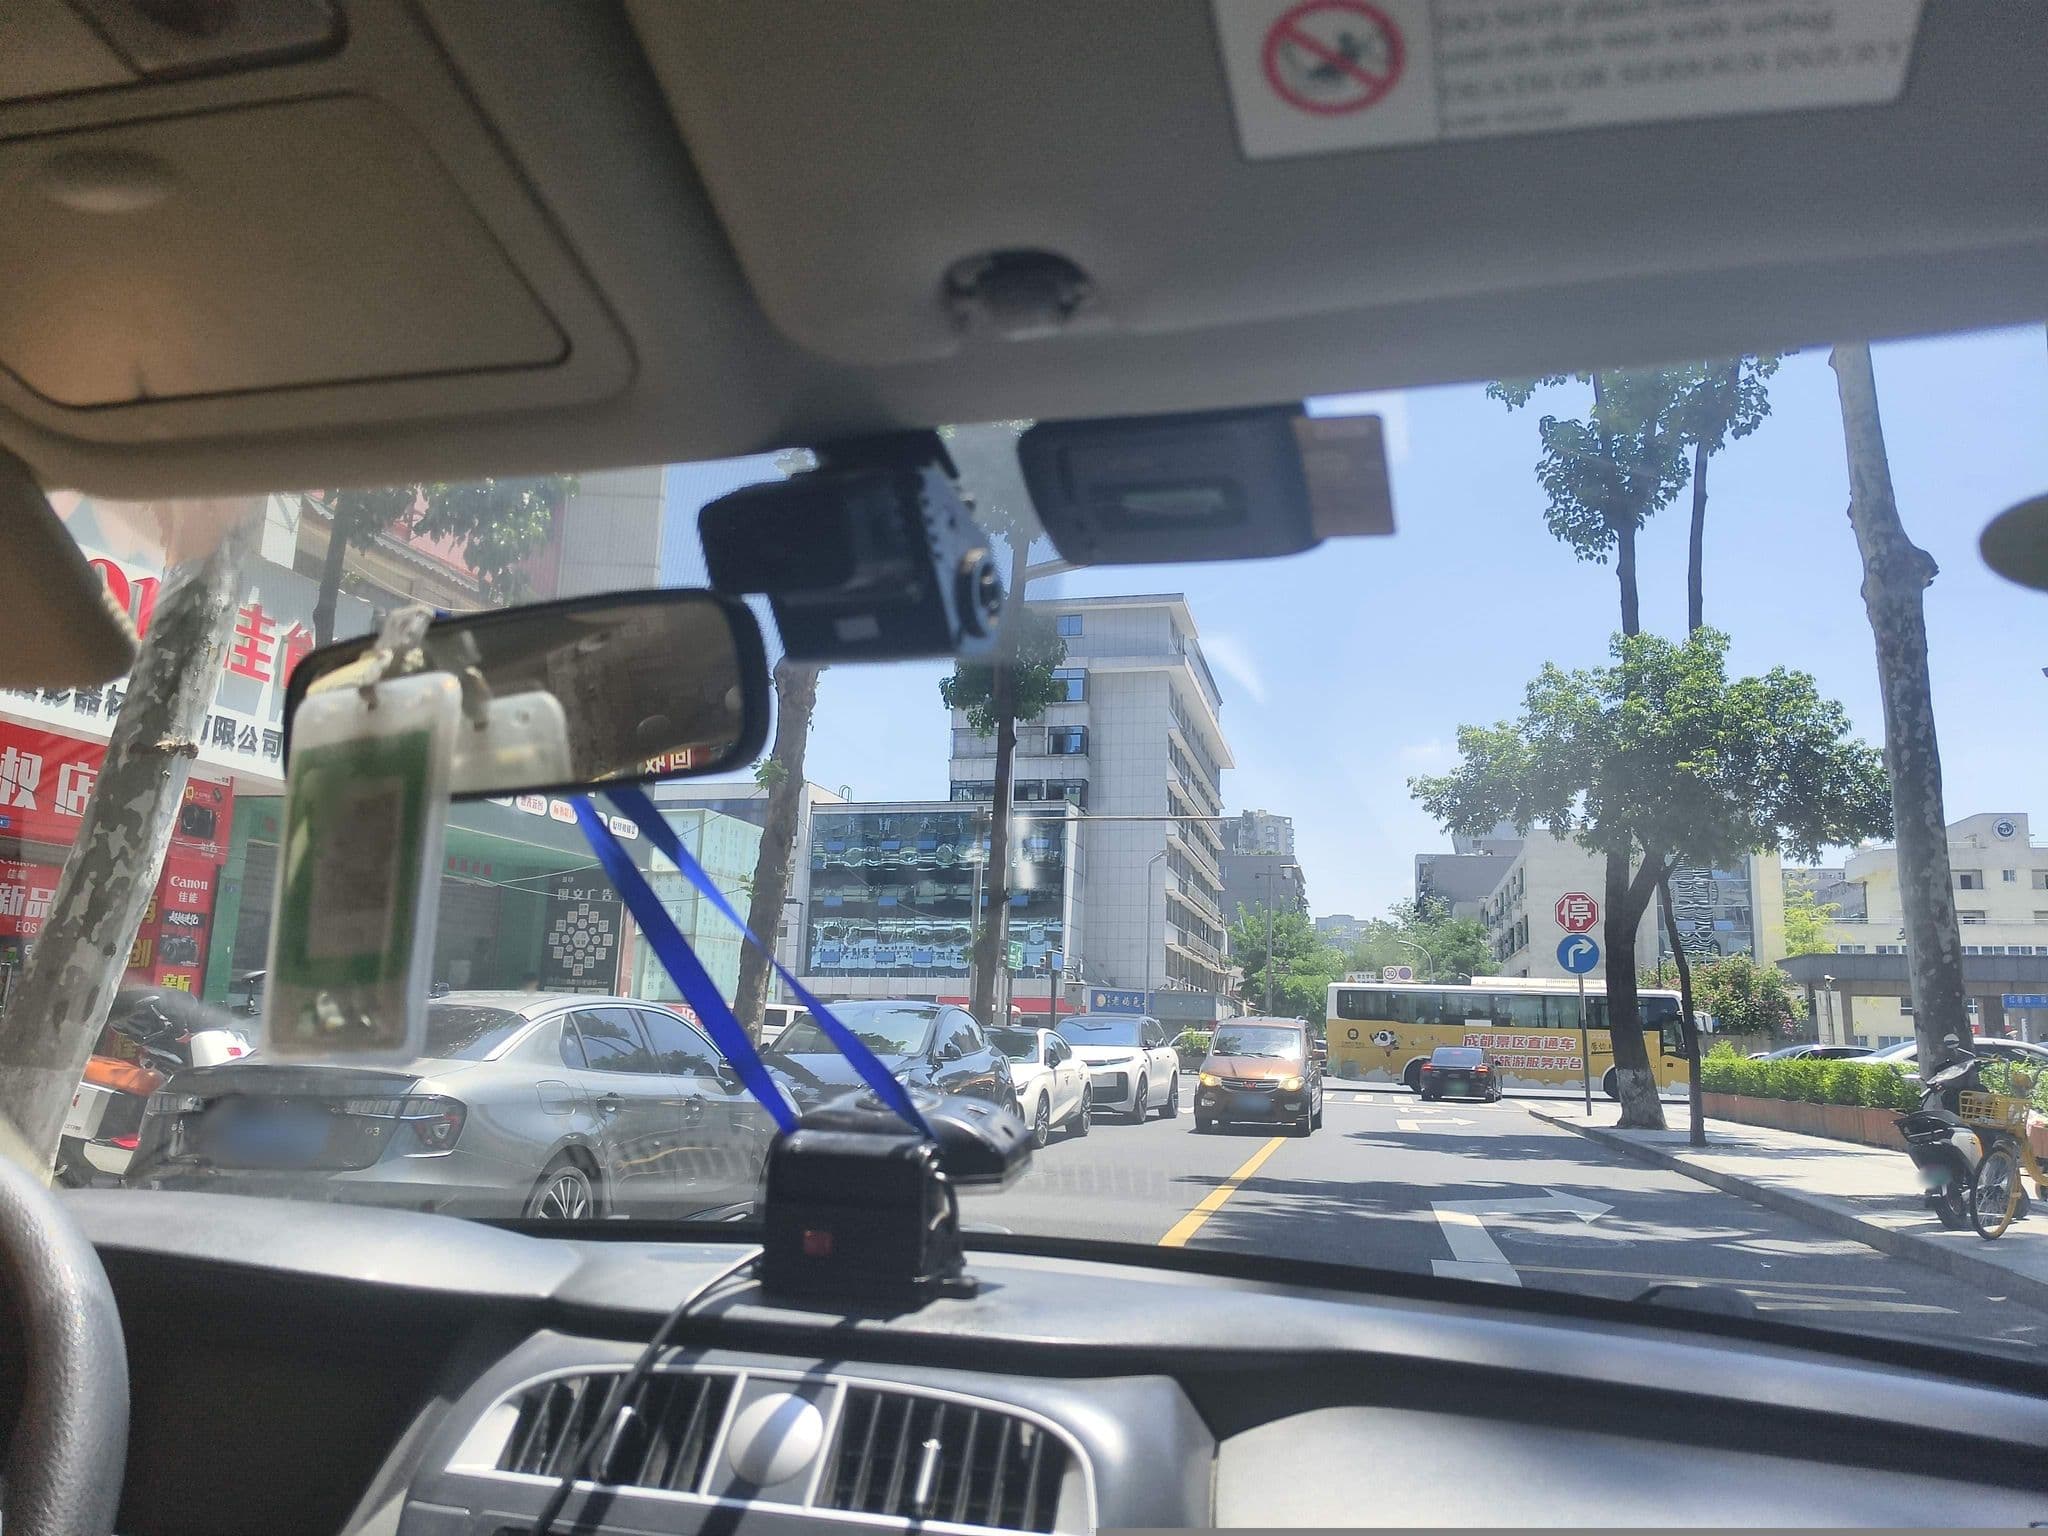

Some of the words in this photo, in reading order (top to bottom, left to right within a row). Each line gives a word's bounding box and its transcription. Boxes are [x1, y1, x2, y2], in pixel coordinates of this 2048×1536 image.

[170, 875, 208, 891] Canon
[0, 882, 56, 918] 新品
[178, 891, 198, 904] 佳能
[1560, 898, 1592, 927] 停
[16, 921, 38, 934] EOS
[1463, 1034, 1576, 1051] 成都景区直通车
